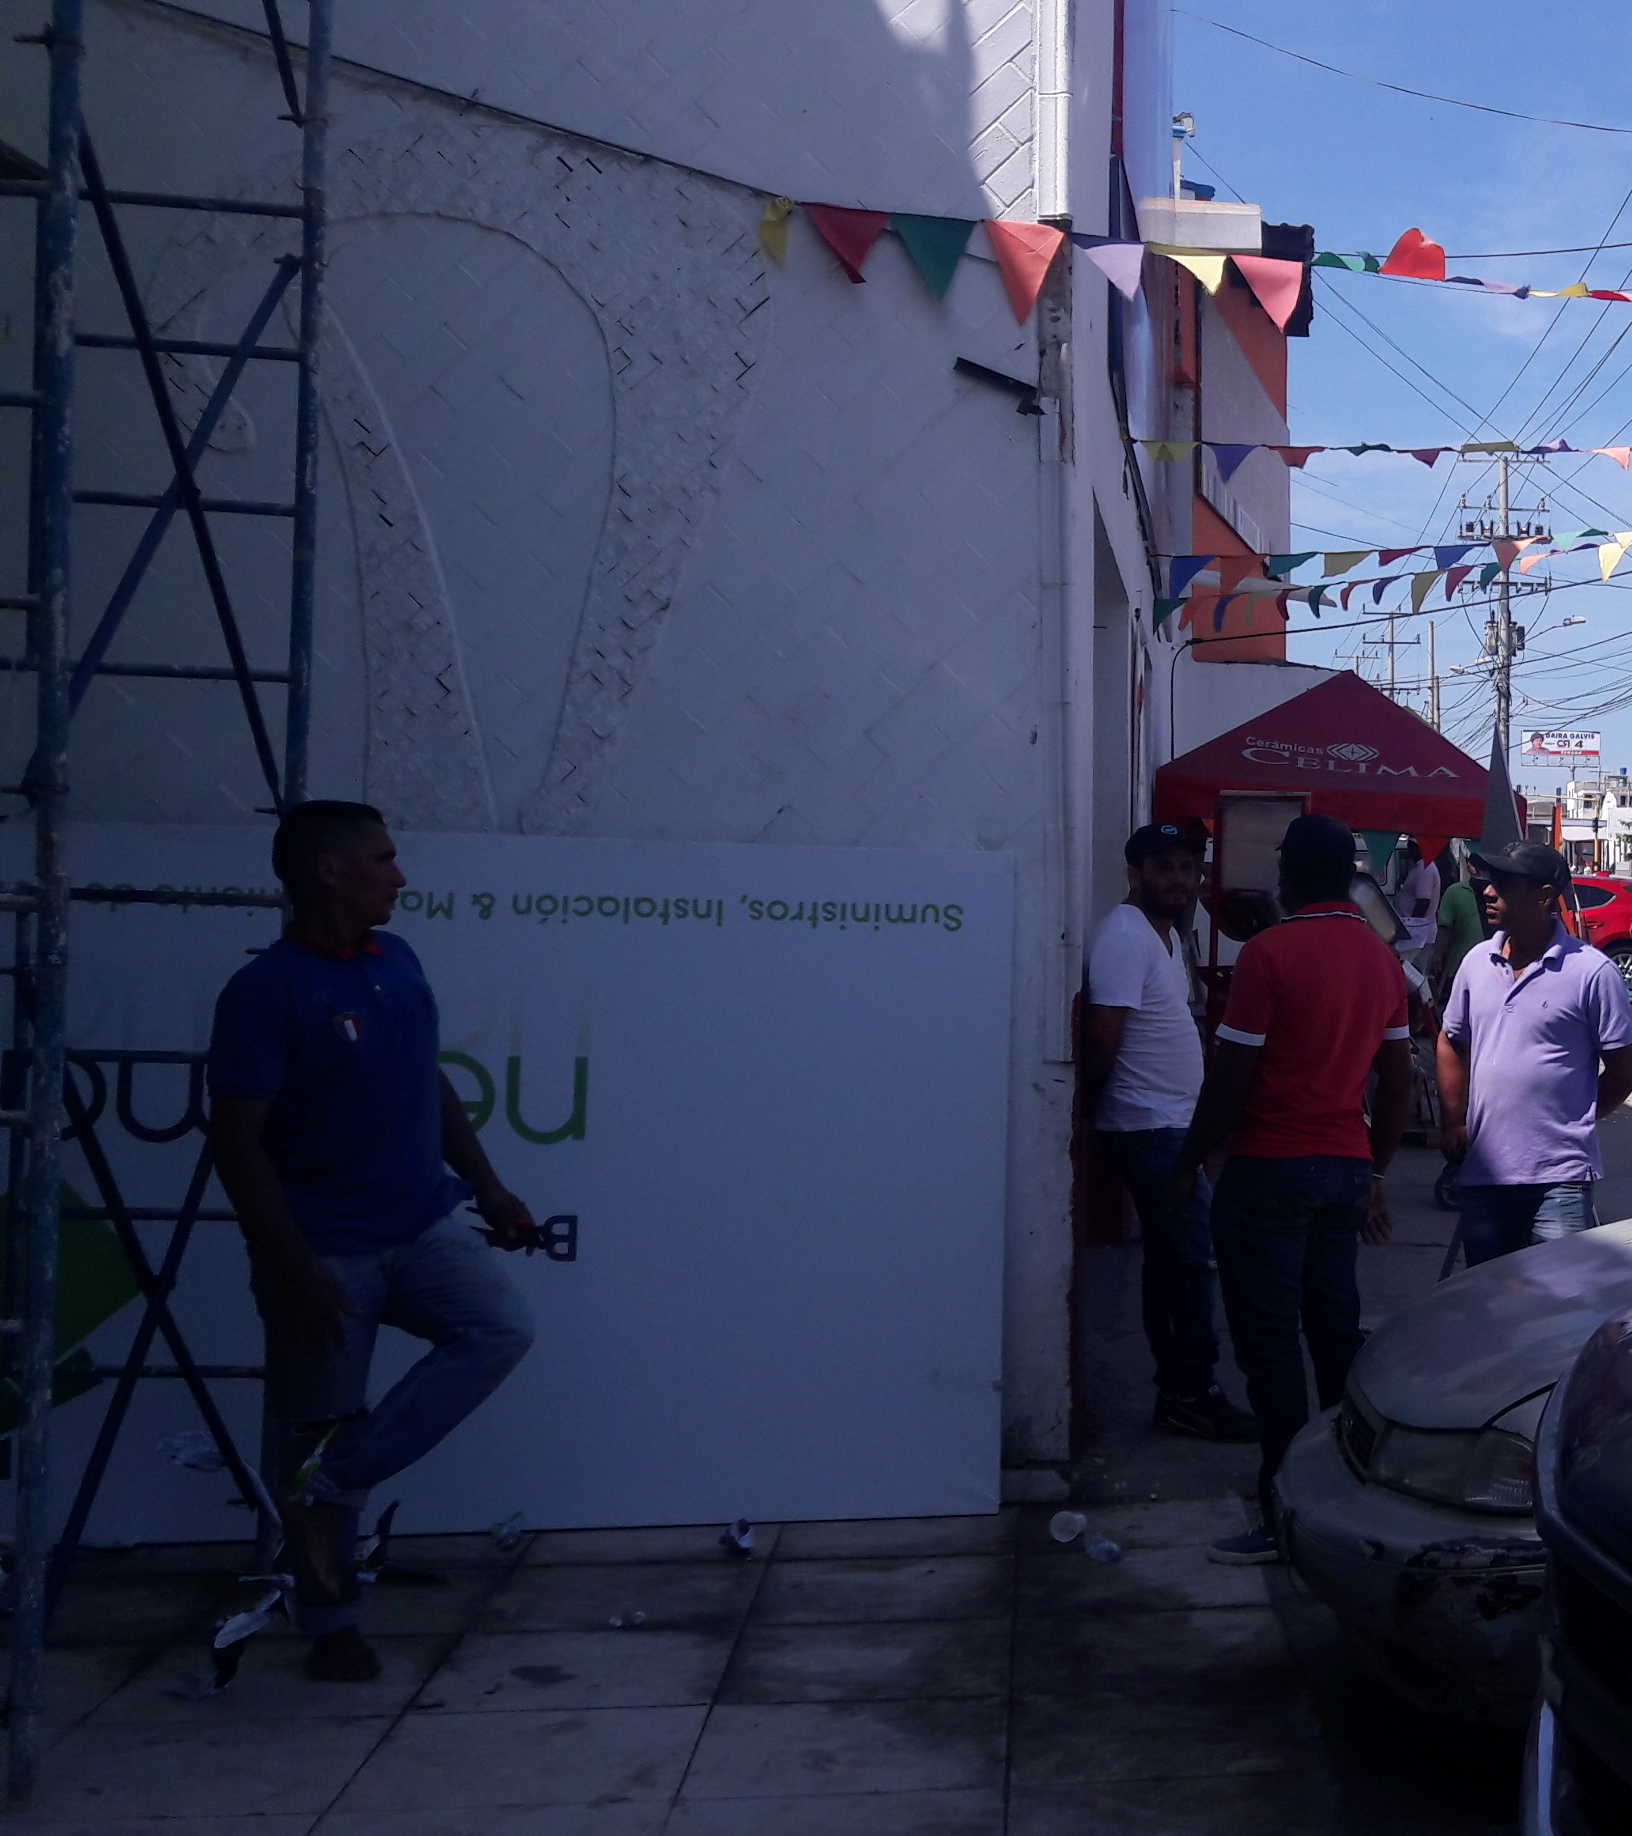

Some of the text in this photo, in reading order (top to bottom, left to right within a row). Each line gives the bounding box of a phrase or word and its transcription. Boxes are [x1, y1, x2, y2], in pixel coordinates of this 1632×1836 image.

[1245, 736, 1324, 755] Cerámicas
[1574, 740, 1584, 748] 4
[1241, 747, 1461, 778] CELIMA
[472, 892, 496, 921] &
[511, 893, 724, 926] Instalación
[740, 894, 964, 932] Suministros,
